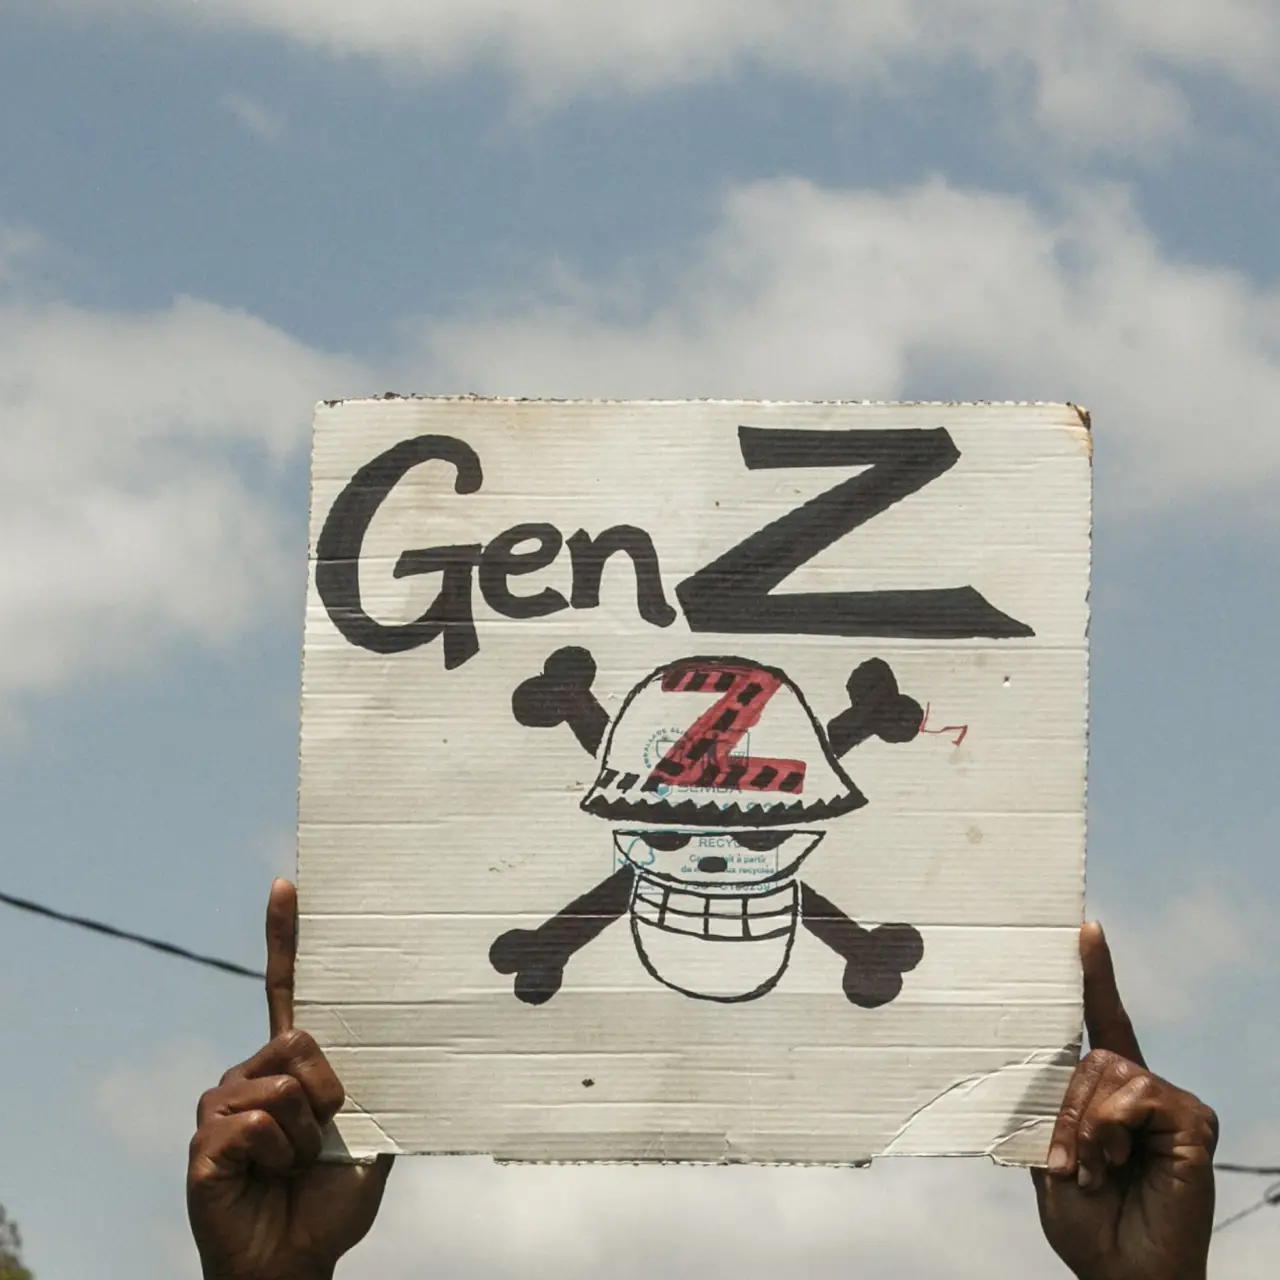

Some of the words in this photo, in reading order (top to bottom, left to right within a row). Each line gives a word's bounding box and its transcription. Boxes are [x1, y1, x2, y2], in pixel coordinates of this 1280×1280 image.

[315, 435, 677, 670] Gen
[675, 426, 1036, 638] Z
[642, 667, 807, 794] Z
[743, 854, 766, 866] partir
